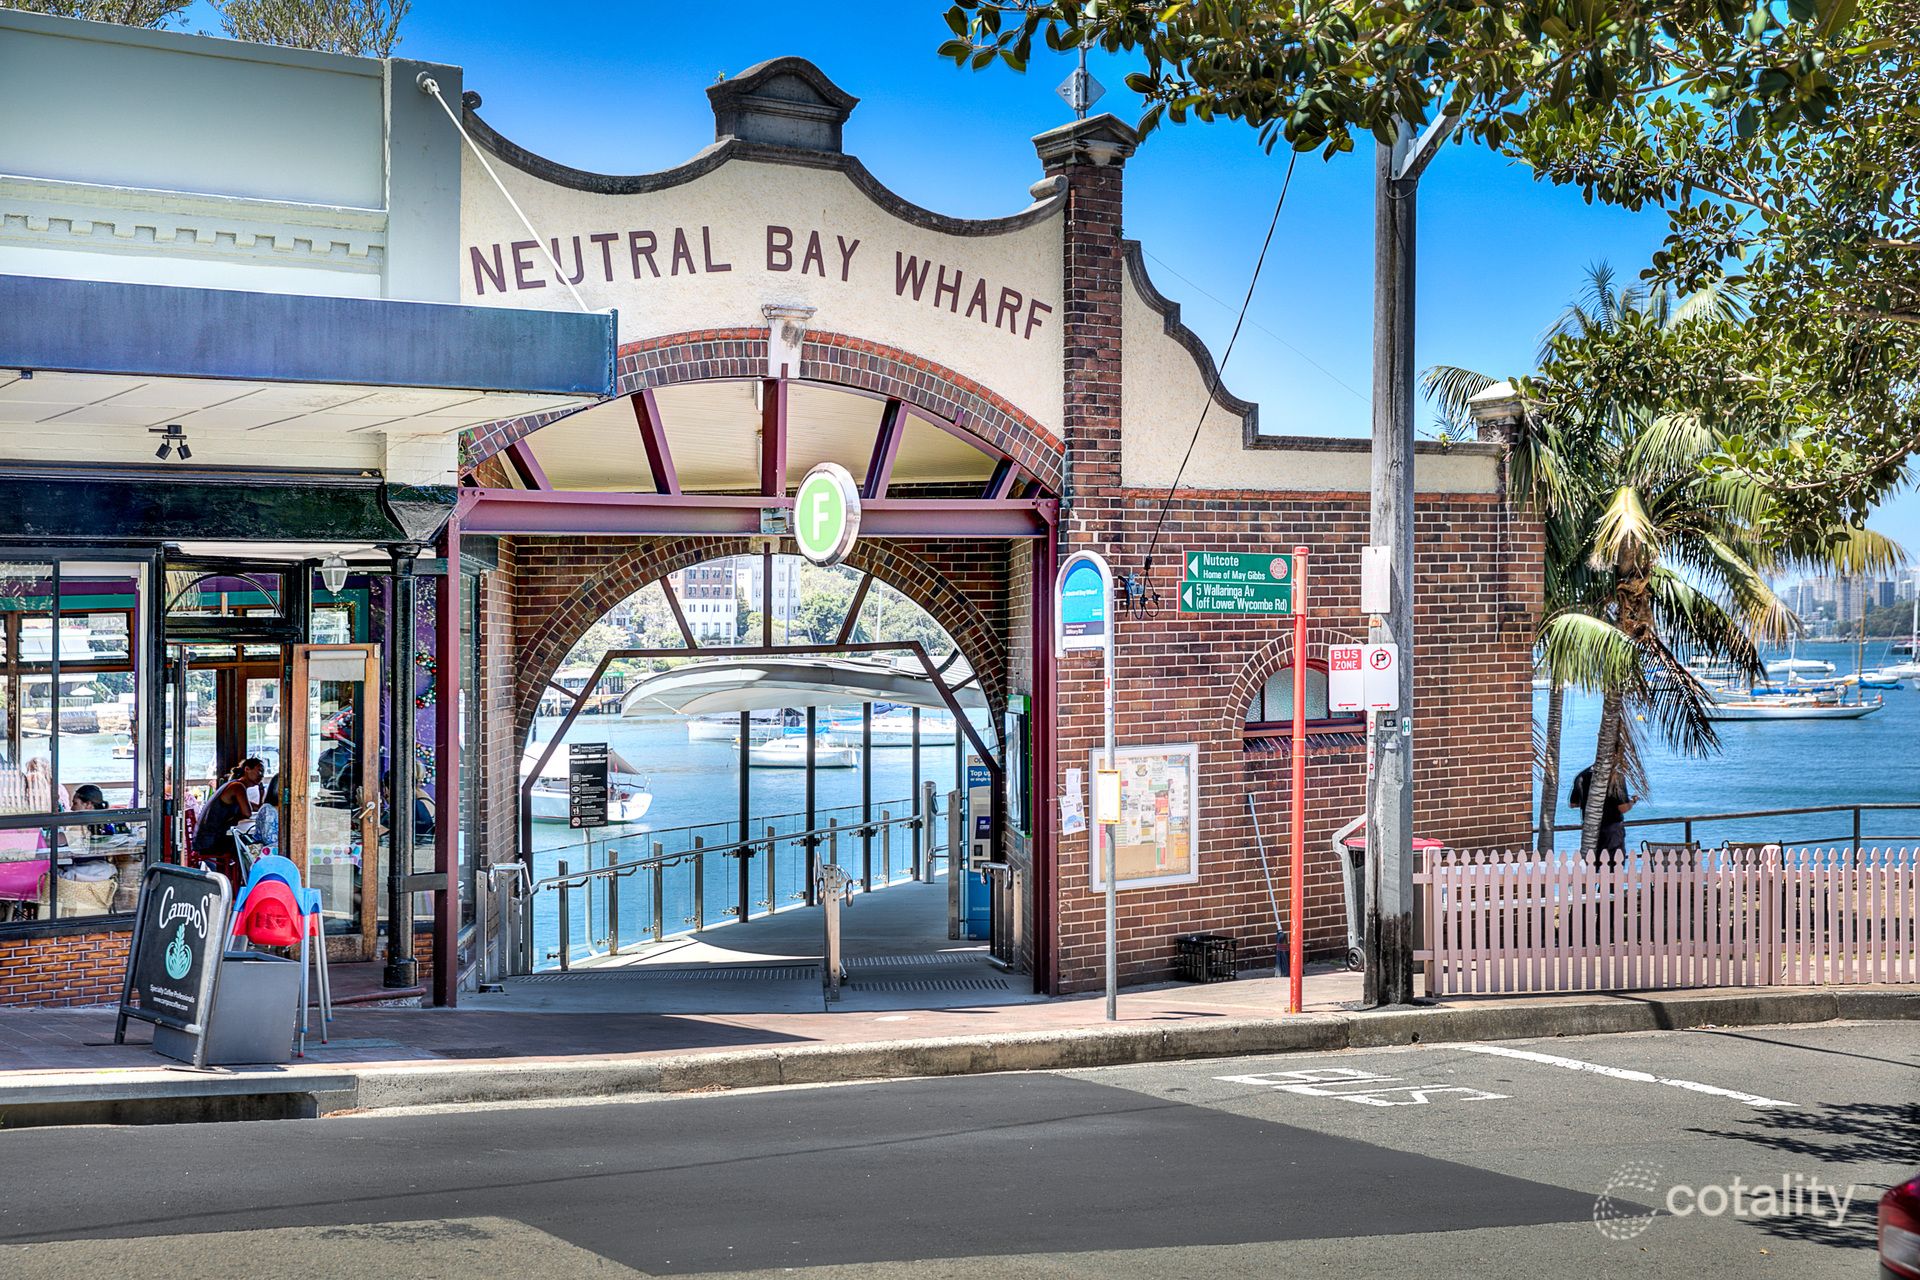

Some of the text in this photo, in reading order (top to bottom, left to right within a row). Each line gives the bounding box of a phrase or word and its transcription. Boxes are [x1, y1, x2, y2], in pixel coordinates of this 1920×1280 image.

[470, 225, 1053, 340] NEUTRAL BAY WHARF
[812, 491, 830, 541] F
[1203, 553, 1239, 567] Nutcote
[1203, 570, 1266, 581] Home of May Gibbs
[1196, 583, 1255, 599] 5 Wallaringa Av
[1196, 597, 1288, 612] (off Lower Wycombe Rd)
[1333, 650, 1359, 659] BUS
[1335, 661, 1358, 670] ZONE
[1403, 720, 1410, 732] H
[969, 769, 983, 777] Top
[1211, 1068, 1515, 1107] BUS
